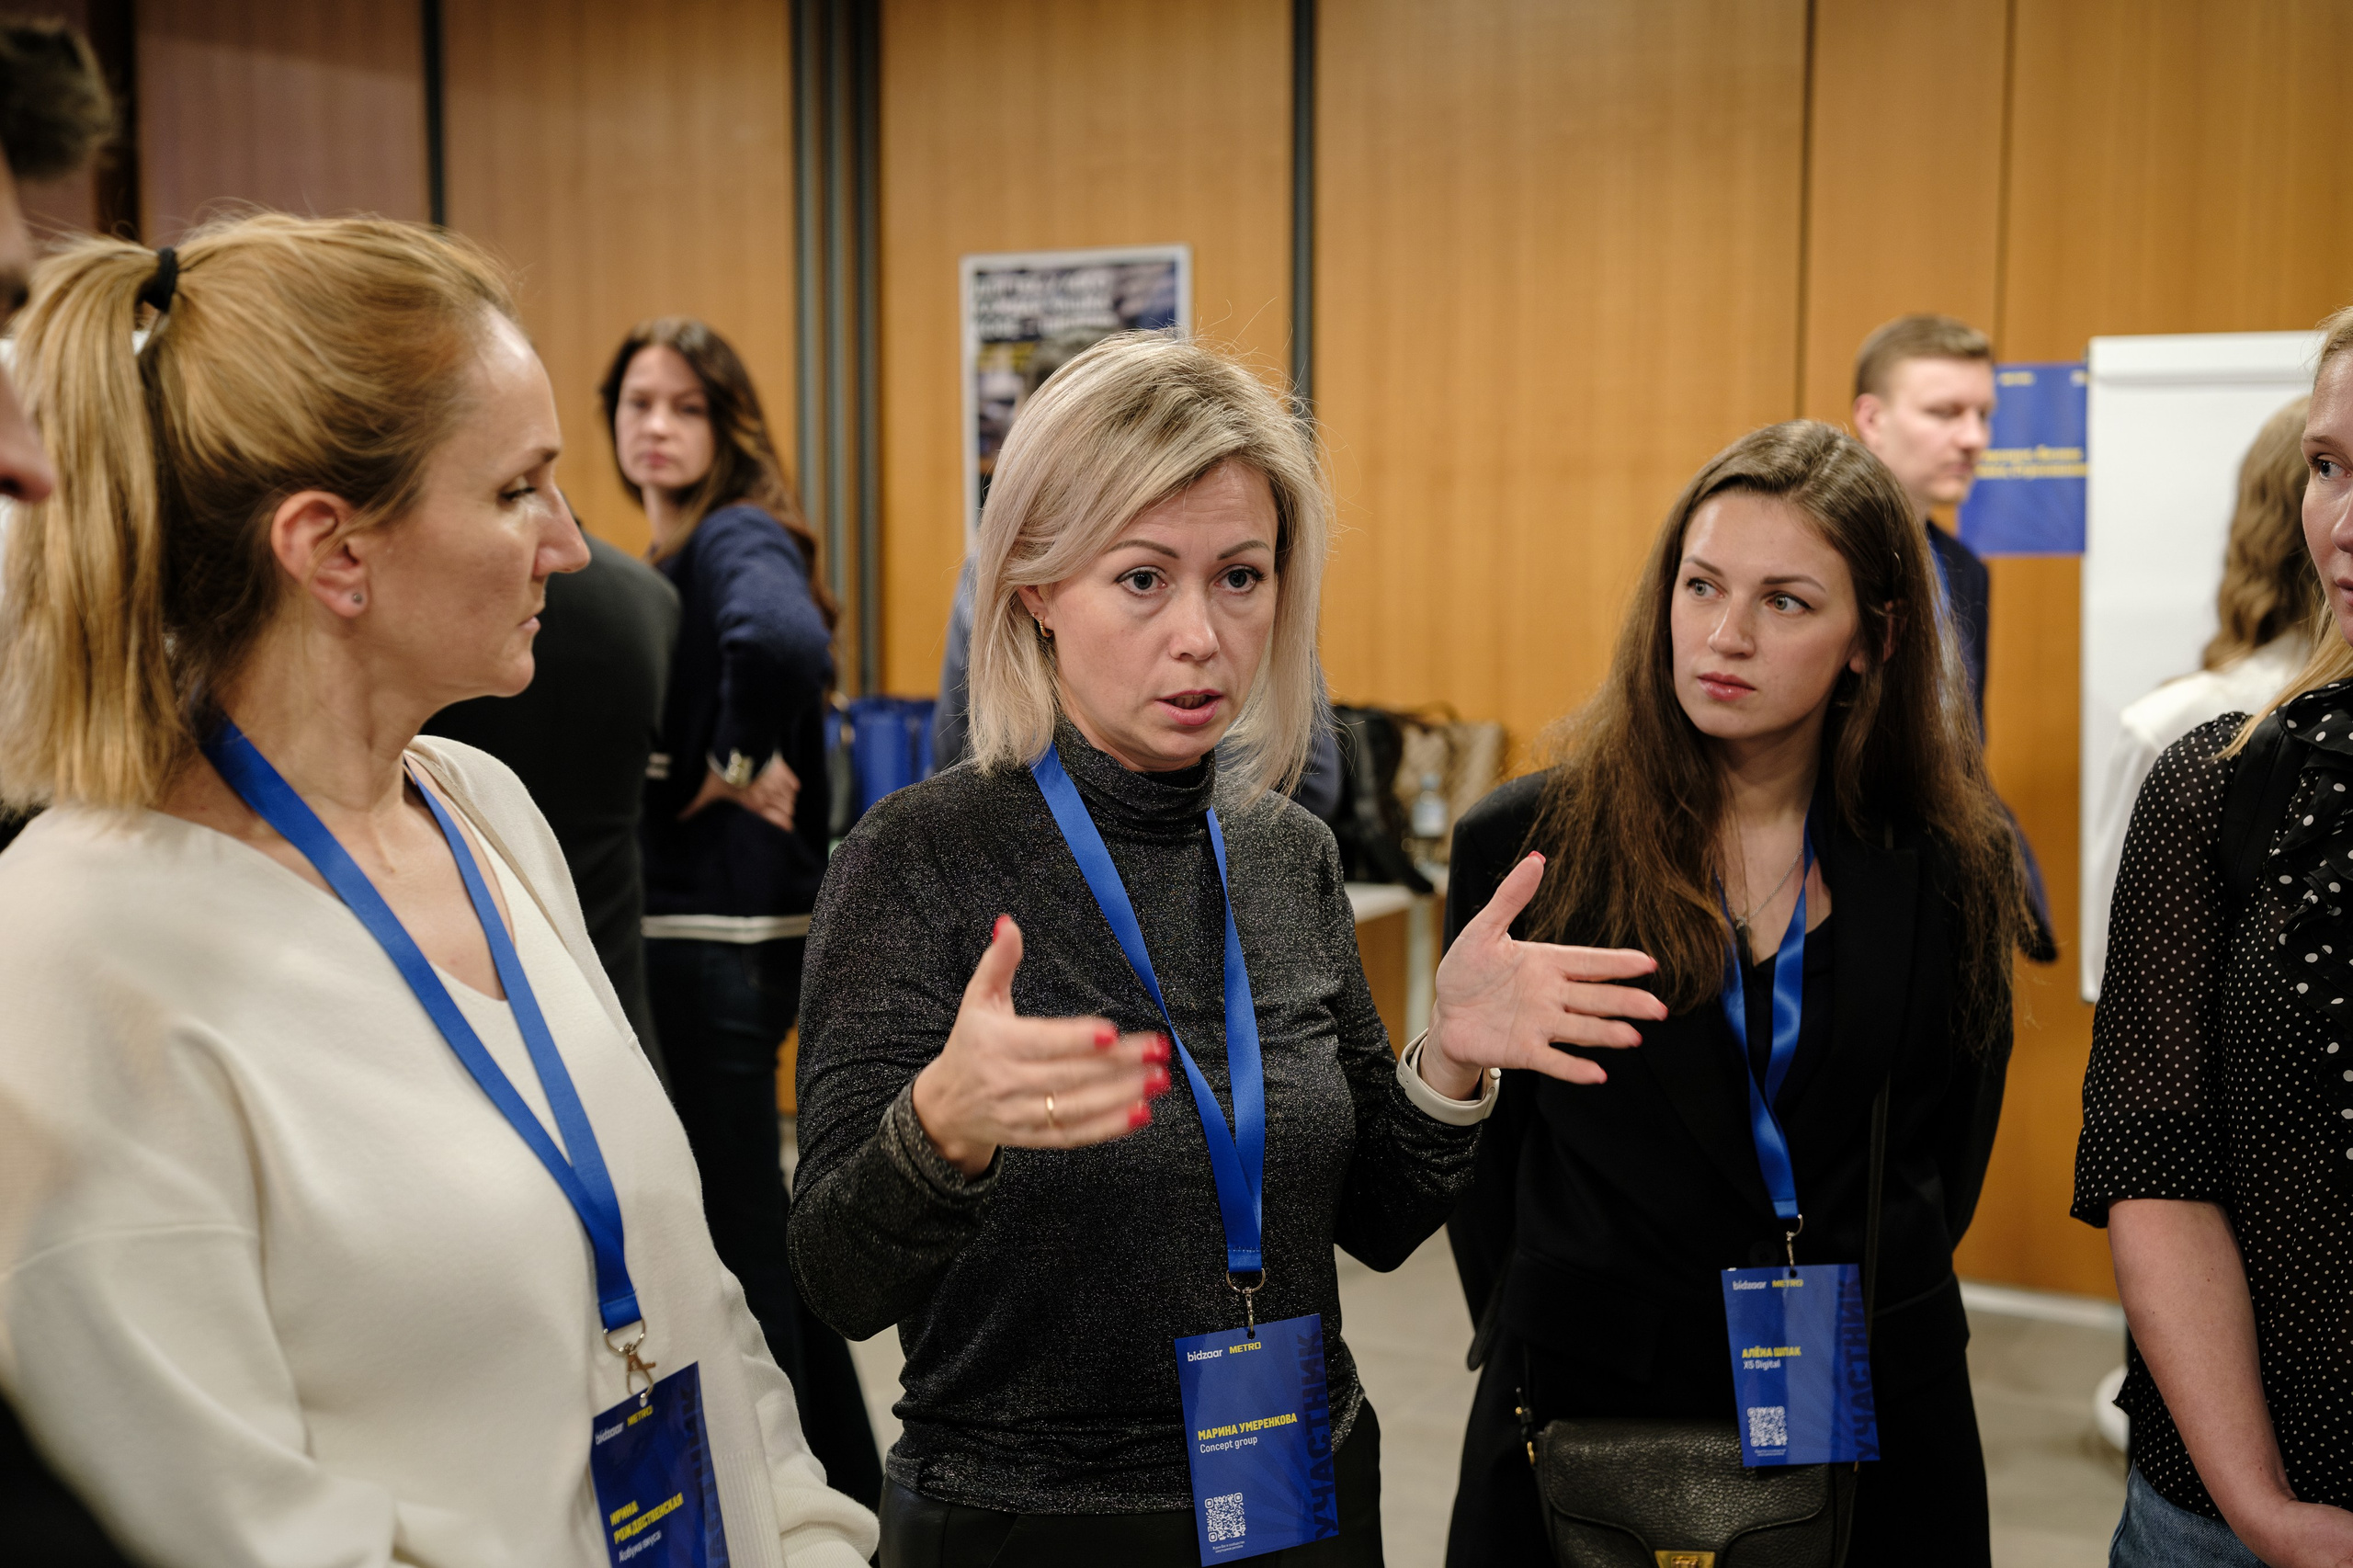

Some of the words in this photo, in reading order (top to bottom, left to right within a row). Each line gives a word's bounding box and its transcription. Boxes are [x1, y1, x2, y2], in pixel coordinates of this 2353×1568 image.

[1733, 1280, 1767, 1290] bidzaar
[1771, 1279, 1803, 1288] METRO
[1188, 1348, 1222, 1362] bidzaar
[1229, 1341, 1261, 1354] METRO
[1742, 1346, 1773, 1358] АЛЁНА
[1774, 1346, 1802, 1358] ШПАК
[1756, 1359, 1781, 1370] Digital
[627, 1404, 654, 1426] METRO
[1198, 1425, 1238, 1440] МАРИНА
[1239, 1413, 1298, 1433] УМЕРЕНКОВА
[1297, 1334, 1339, 1540] УЧАСТНИК
[1199, 1439, 1233, 1454] Concept
[1234, 1436, 1258, 1449] group
[609, 1500, 640, 1527] ИРИНА
